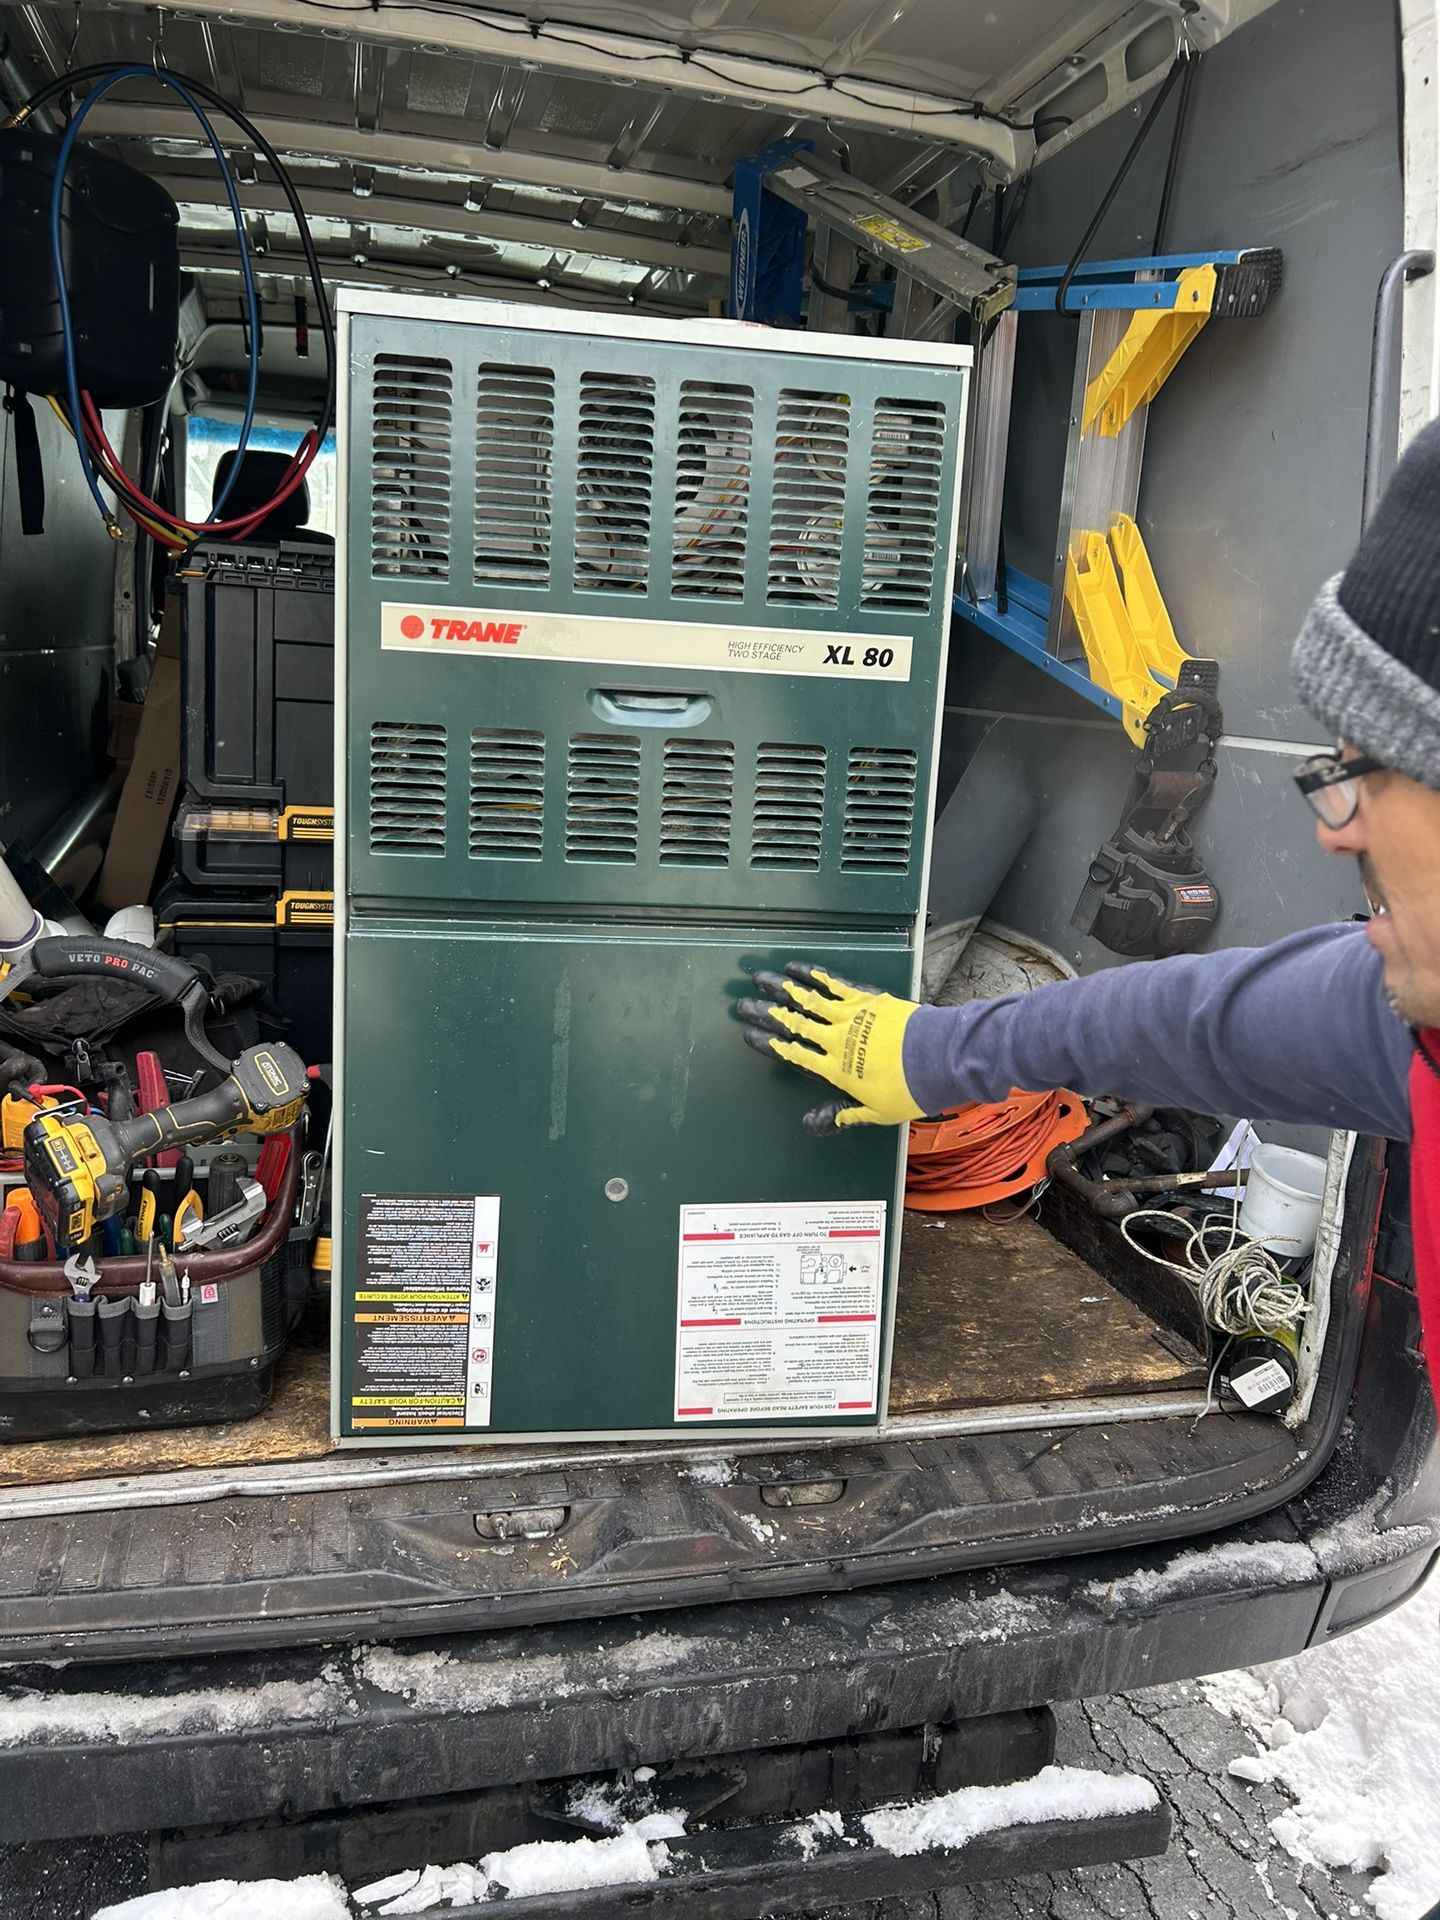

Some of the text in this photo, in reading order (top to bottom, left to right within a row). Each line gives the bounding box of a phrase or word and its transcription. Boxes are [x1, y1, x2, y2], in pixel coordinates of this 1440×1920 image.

[738, 230, 747, 300] WERNER
[430, 618, 523, 645] TRANE
[727, 640, 805, 654] HIGH EFFICIENCY
[727, 650, 782, 661] TWO STAGE
[822, 644, 894, 668] XL 80
[68, 953, 154, 979] VETO PRO PAC
[856, 1012, 876, 1080] FIRM GRIP
